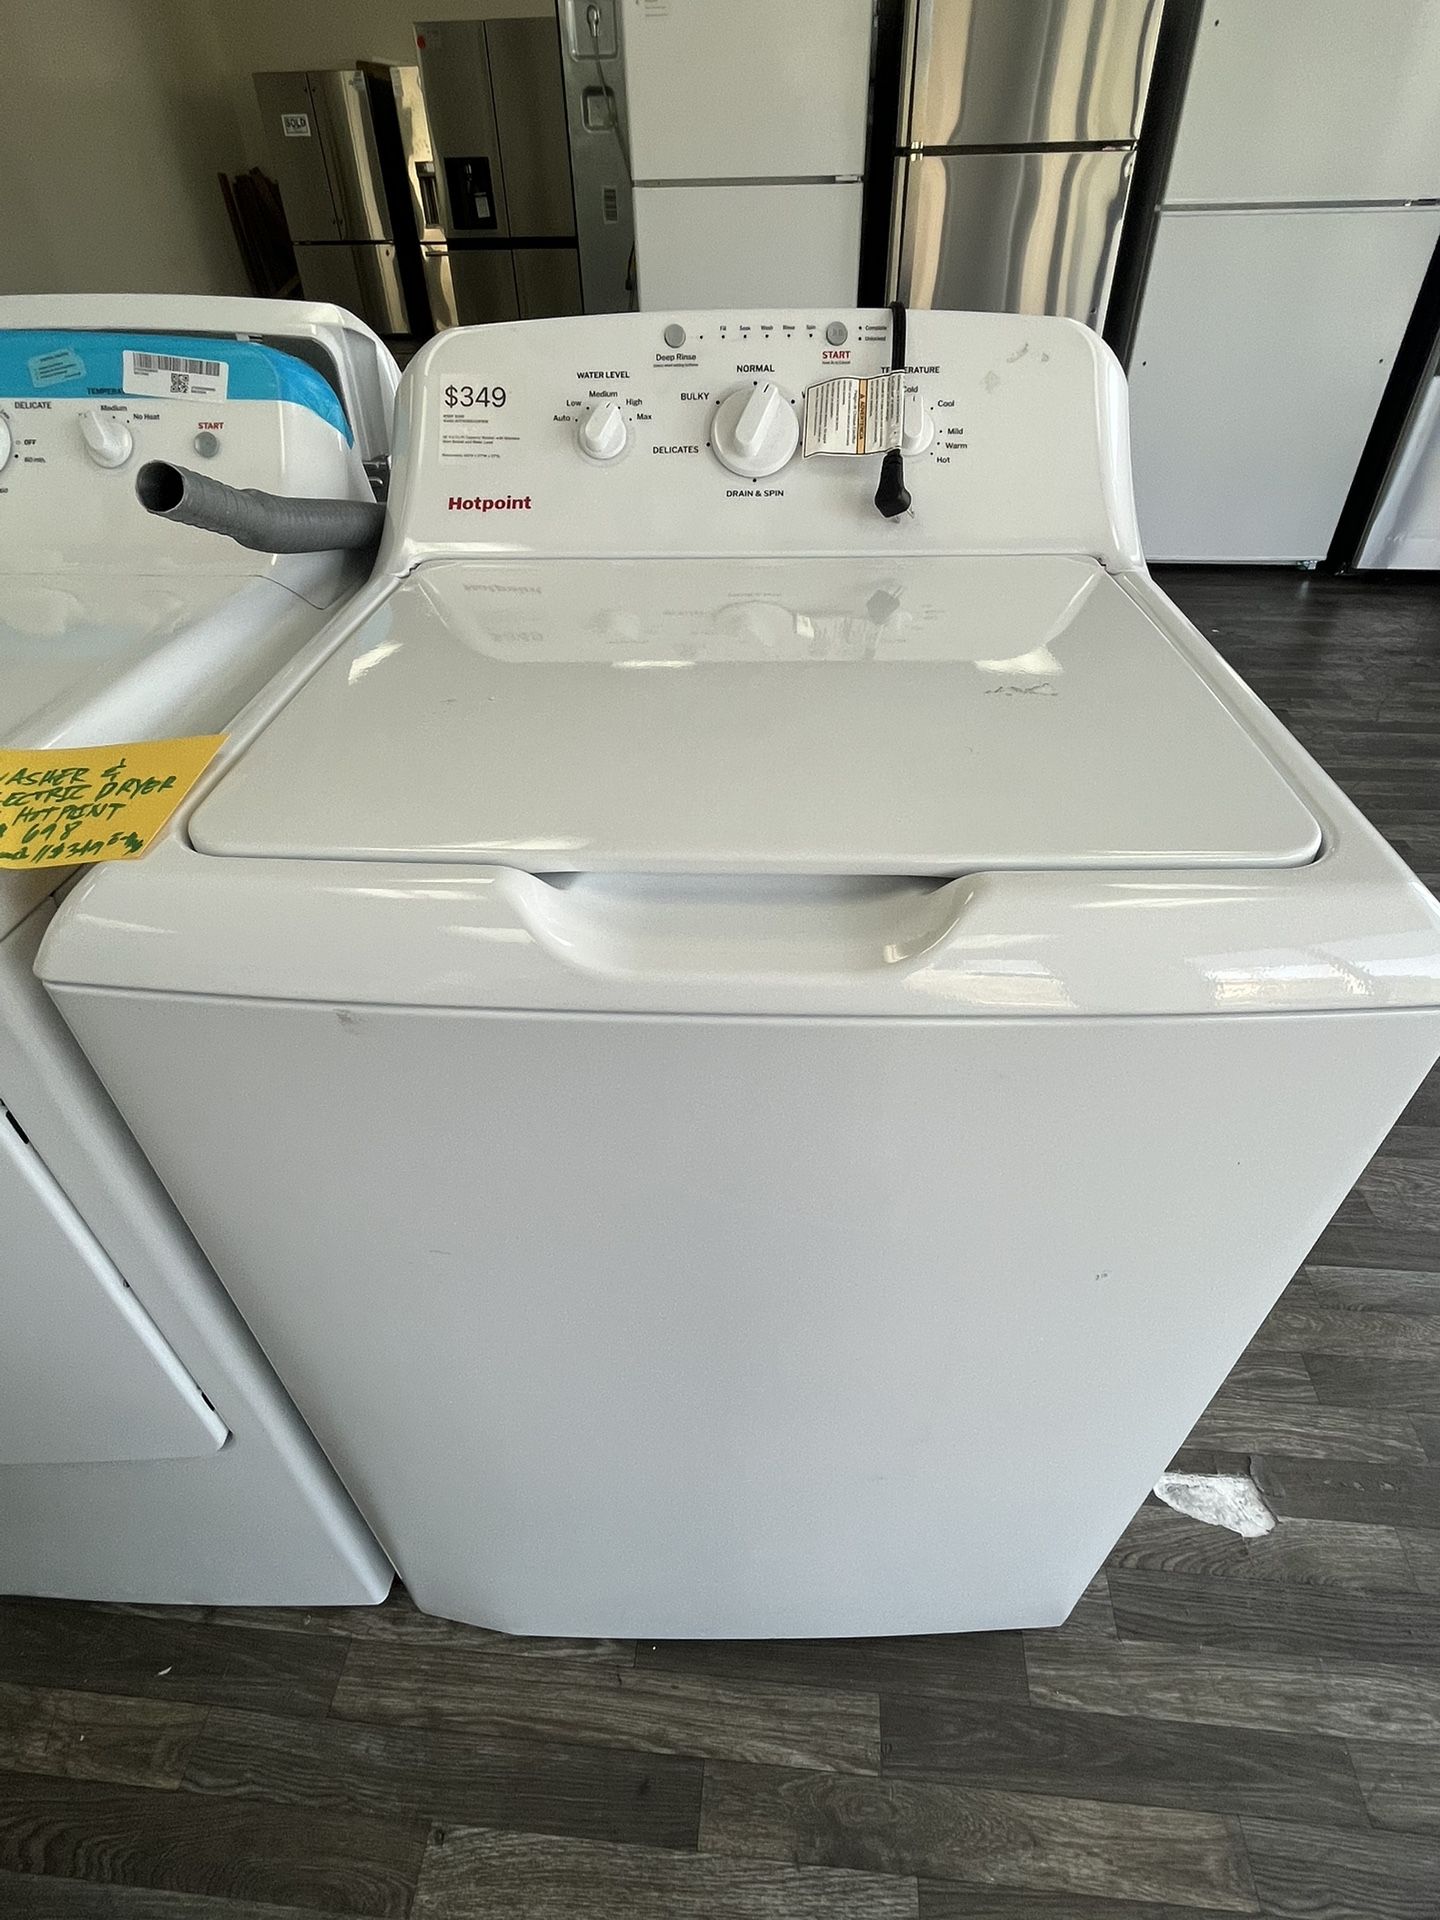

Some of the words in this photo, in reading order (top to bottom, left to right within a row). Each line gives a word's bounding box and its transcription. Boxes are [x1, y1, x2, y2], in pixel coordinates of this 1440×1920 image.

[656, 353, 675, 363] Deep
[676, 353, 697, 361] Rinse
[822, 350, 851, 360] START
[736, 364, 775, 373] NORMAL
[577, 371, 604, 379] WATER
[605, 371, 630, 379] LEVEL
[444, 384, 507, 409] $349
[588, 390, 618, 398] Medium
[680, 392, 710, 401] BULKY
[14, 401, 52, 410] DELICATE
[625, 398, 643, 407] High
[937, 400, 955, 408] Cool
[198, 422, 225, 430] START
[652, 446, 699, 455] DELICATES
[726, 490, 754, 498] DRAIN
[448, 495, 532, 513] Hotpoint
[0, 767, 90, 786] ASHER
